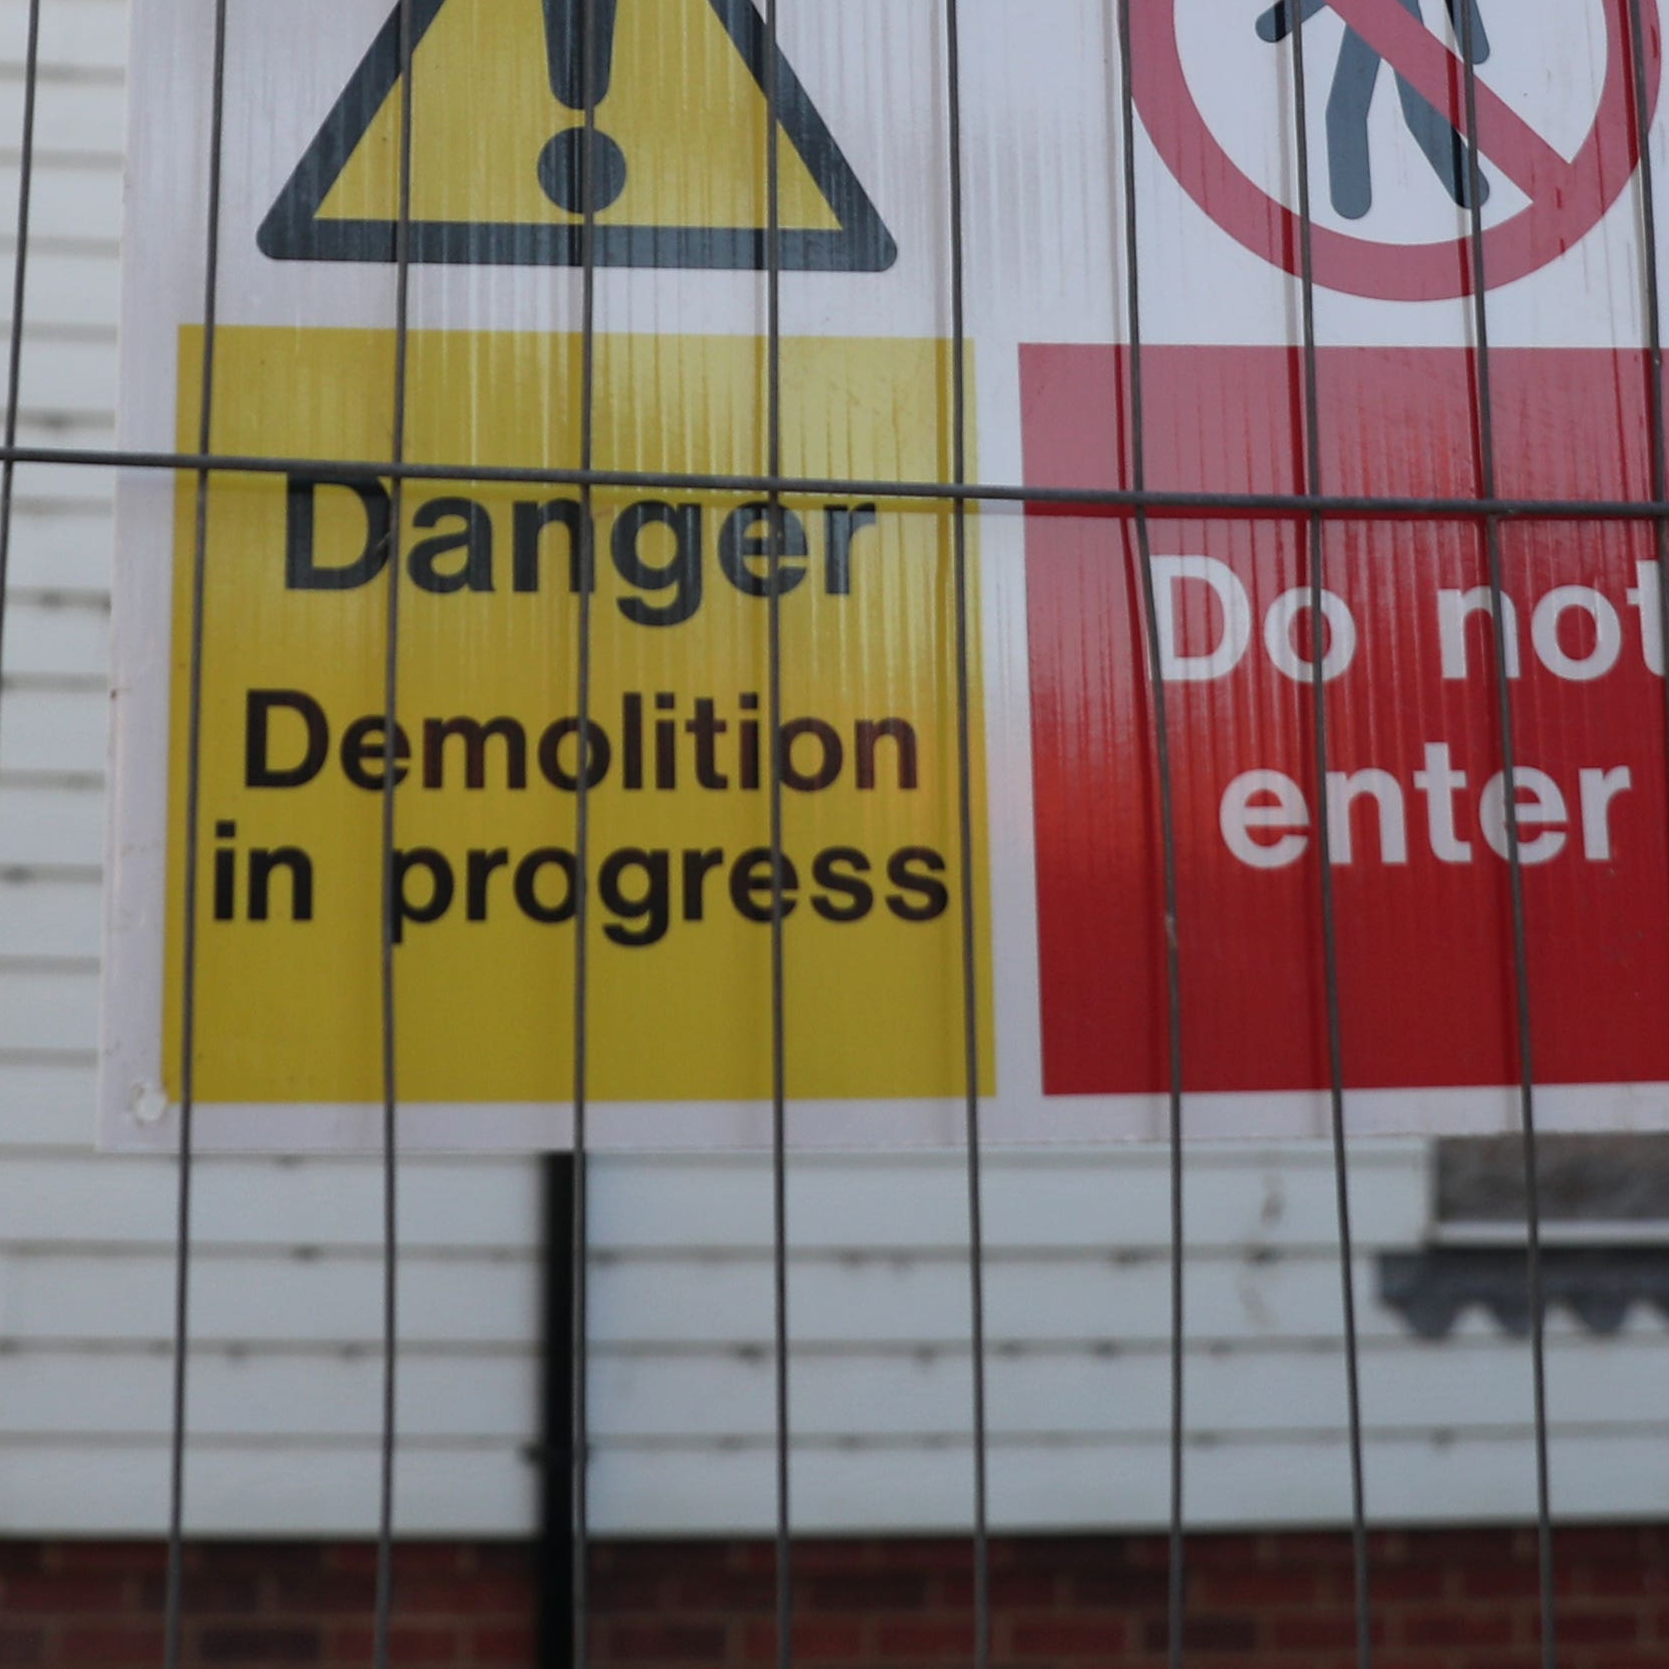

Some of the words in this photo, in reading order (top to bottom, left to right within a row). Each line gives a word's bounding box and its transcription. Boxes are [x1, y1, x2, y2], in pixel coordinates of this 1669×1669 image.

[283, 473, 875, 627] Danger
[1148, 553, 1355, 683] Do
[244, 687, 918, 792] Demolition
[1220, 742, 1632, 870] enter
[213, 819, 313, 922] in
[393, 843, 948, 945] progress
